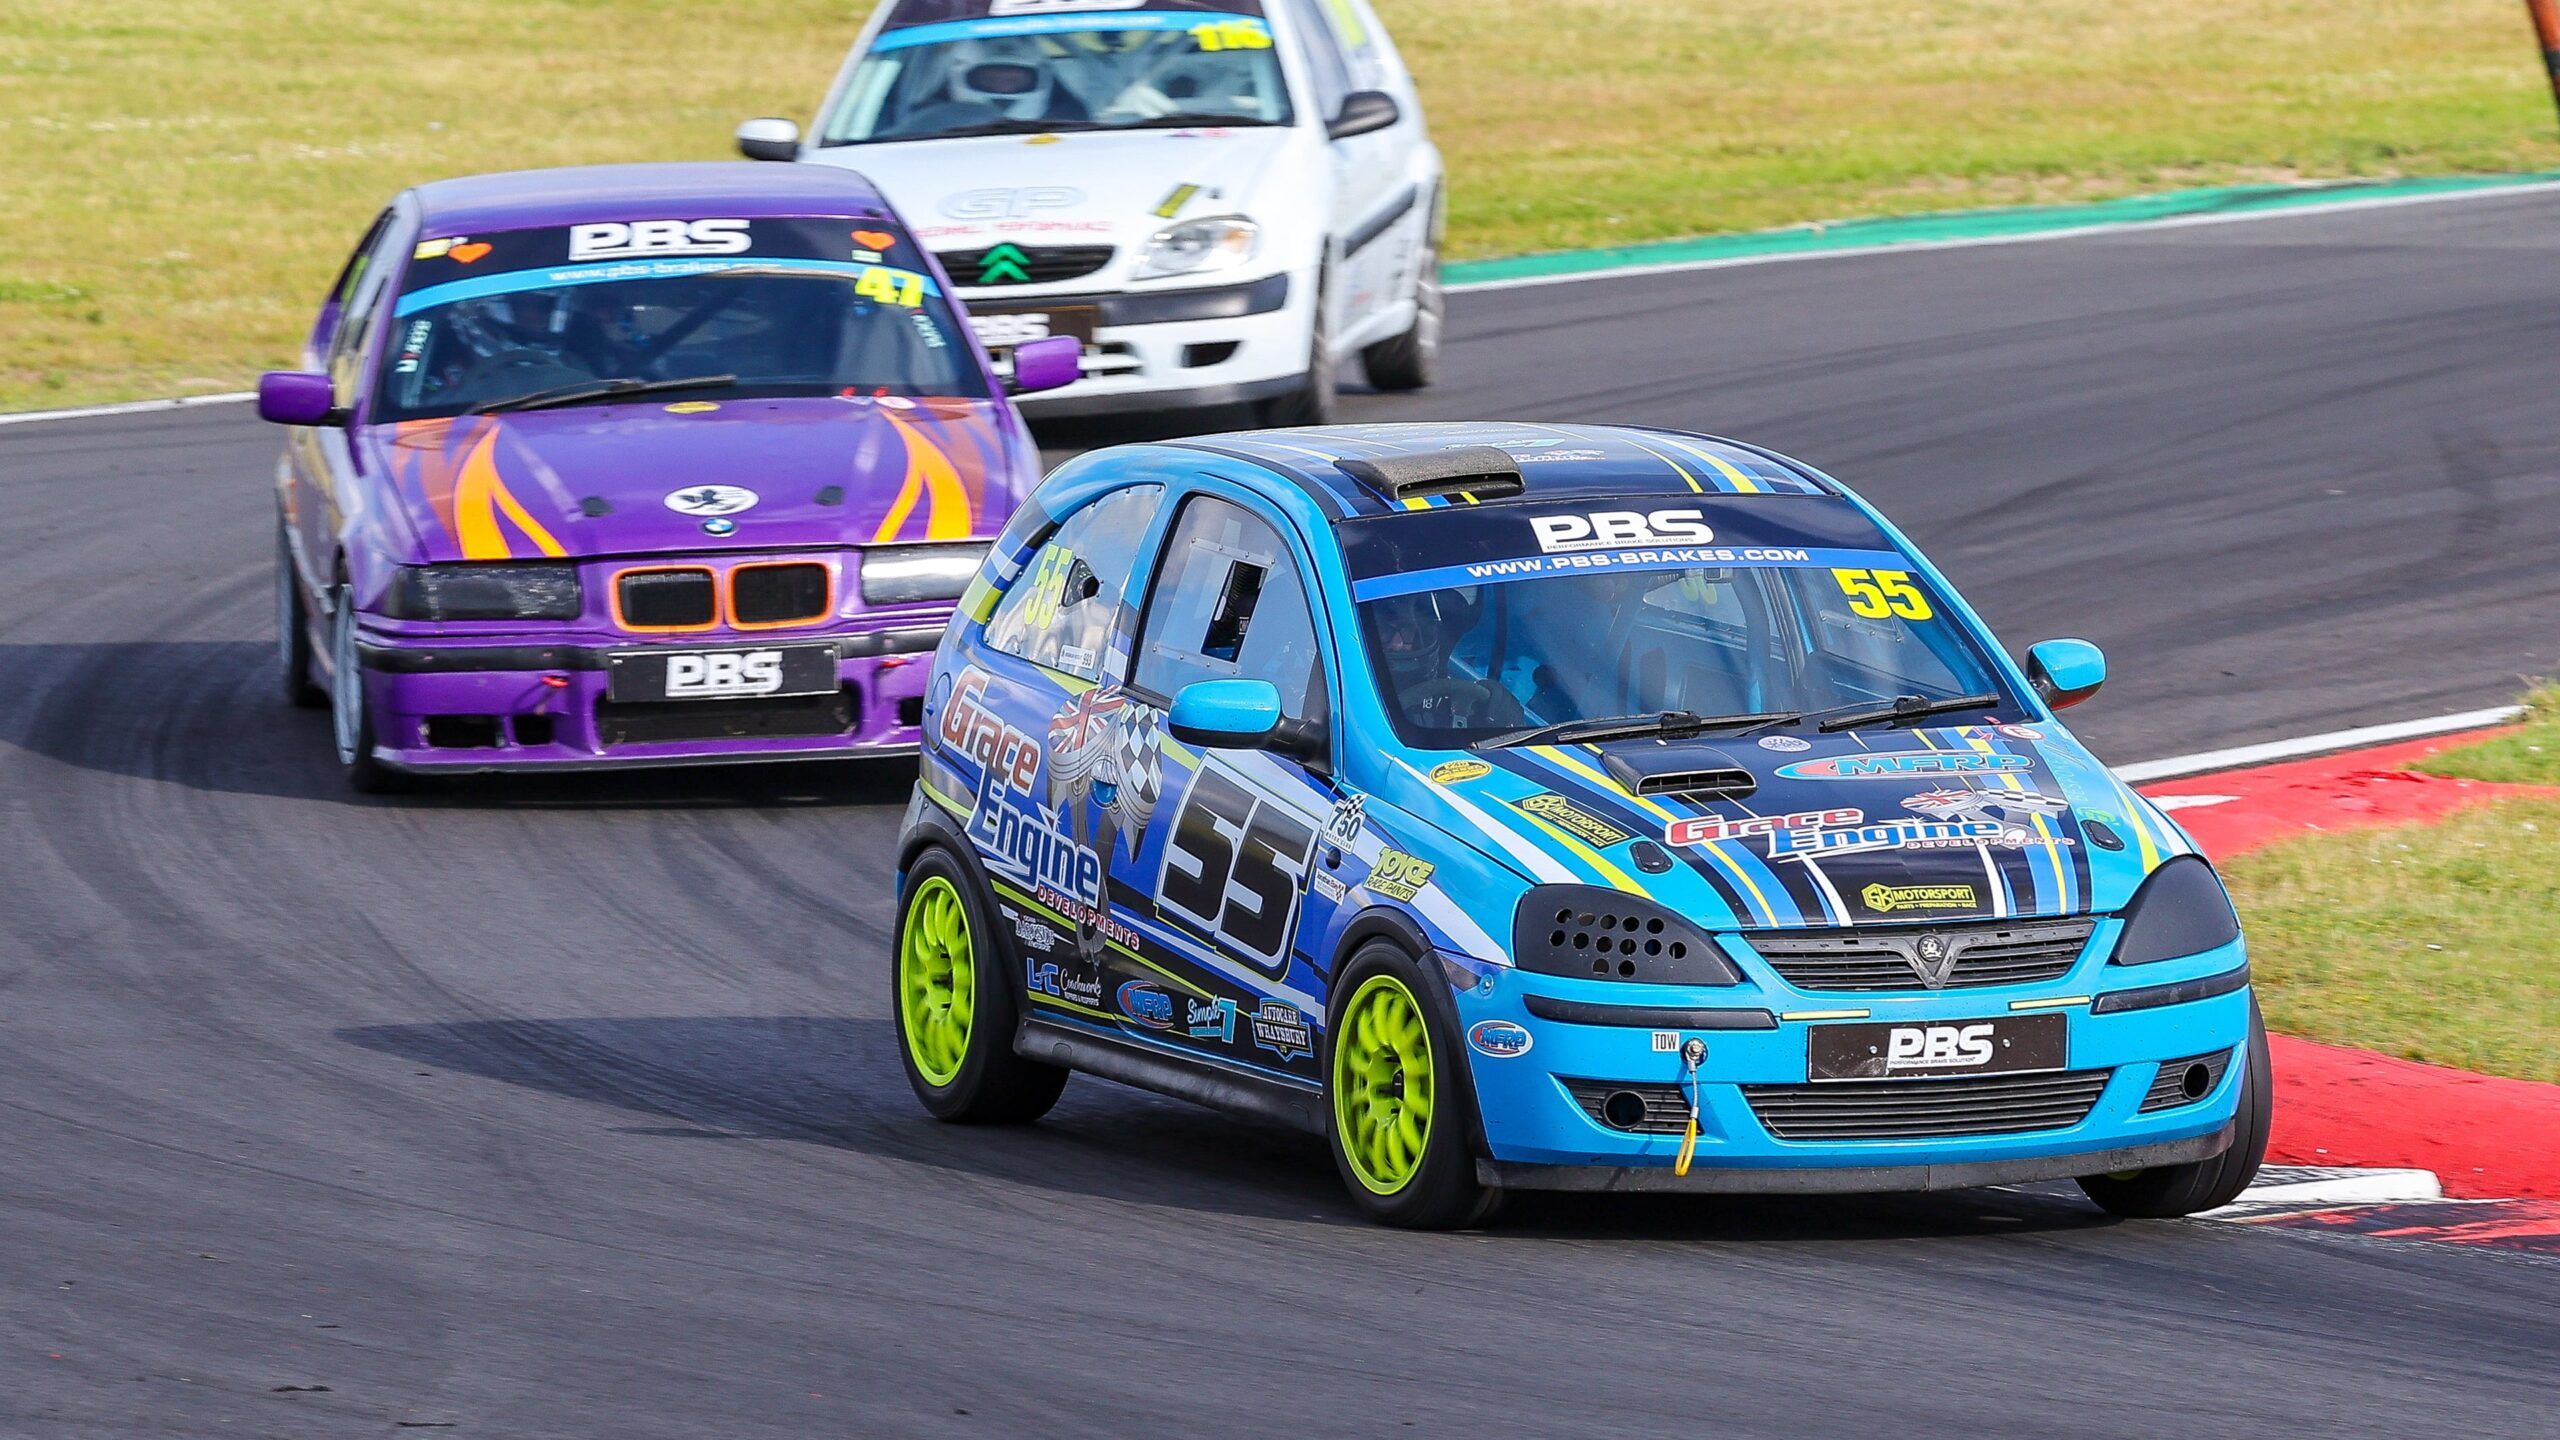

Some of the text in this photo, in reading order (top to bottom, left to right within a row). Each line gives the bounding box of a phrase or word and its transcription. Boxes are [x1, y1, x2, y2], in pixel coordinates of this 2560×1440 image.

[937, 186, 1088, 220] GP
[568, 219, 752, 260] PBS
[854, 267, 923, 307] 47
[1529, 509, 1715, 553] PBS
[1547, 540, 1611, 550] PERFORMANCE
[1645, 536, 1694, 544] SOLUTIONS
[1466, 548, 1810, 578] WWW.PBS-BRAKES.COM
[1024, 543, 1073, 630] 55
[1830, 567, 1934, 620] 55
[666, 651, 783, 697] PBS
[942, 666, 1041, 798] Grace
[1835, 754, 2035, 777] MFRP
[965, 767, 1101, 908] Engine
[1327, 806, 1361, 842] 750
[1549, 804, 1622, 841] MOTORSPORT
[1665, 807, 1864, 848] Grace
[1767, 819, 2004, 860] Engine
[1158, 762, 1319, 960] 55
[1906, 837, 2076, 849] DEVELOPMENTS
[1372, 847, 1435, 888] JOYCE
[1385, 881, 1414, 899] PAINTS
[1893, 888, 1971, 901] MOTORSPORT
[1037, 883, 1140, 951] DEVELOPMENTS
[1127, 988, 1173, 1021] MFRP
[1187, 995, 1221, 1029] Simple
[1262, 1004, 1299, 1025] AUTOCARE
[1255, 1023, 1307, 1046] WRAYSBURY
[1481, 1027, 1527, 1050] MFRP
[1654, 1033, 1678, 1050] TOW
[1887, 1024, 1995, 1068] PBS
